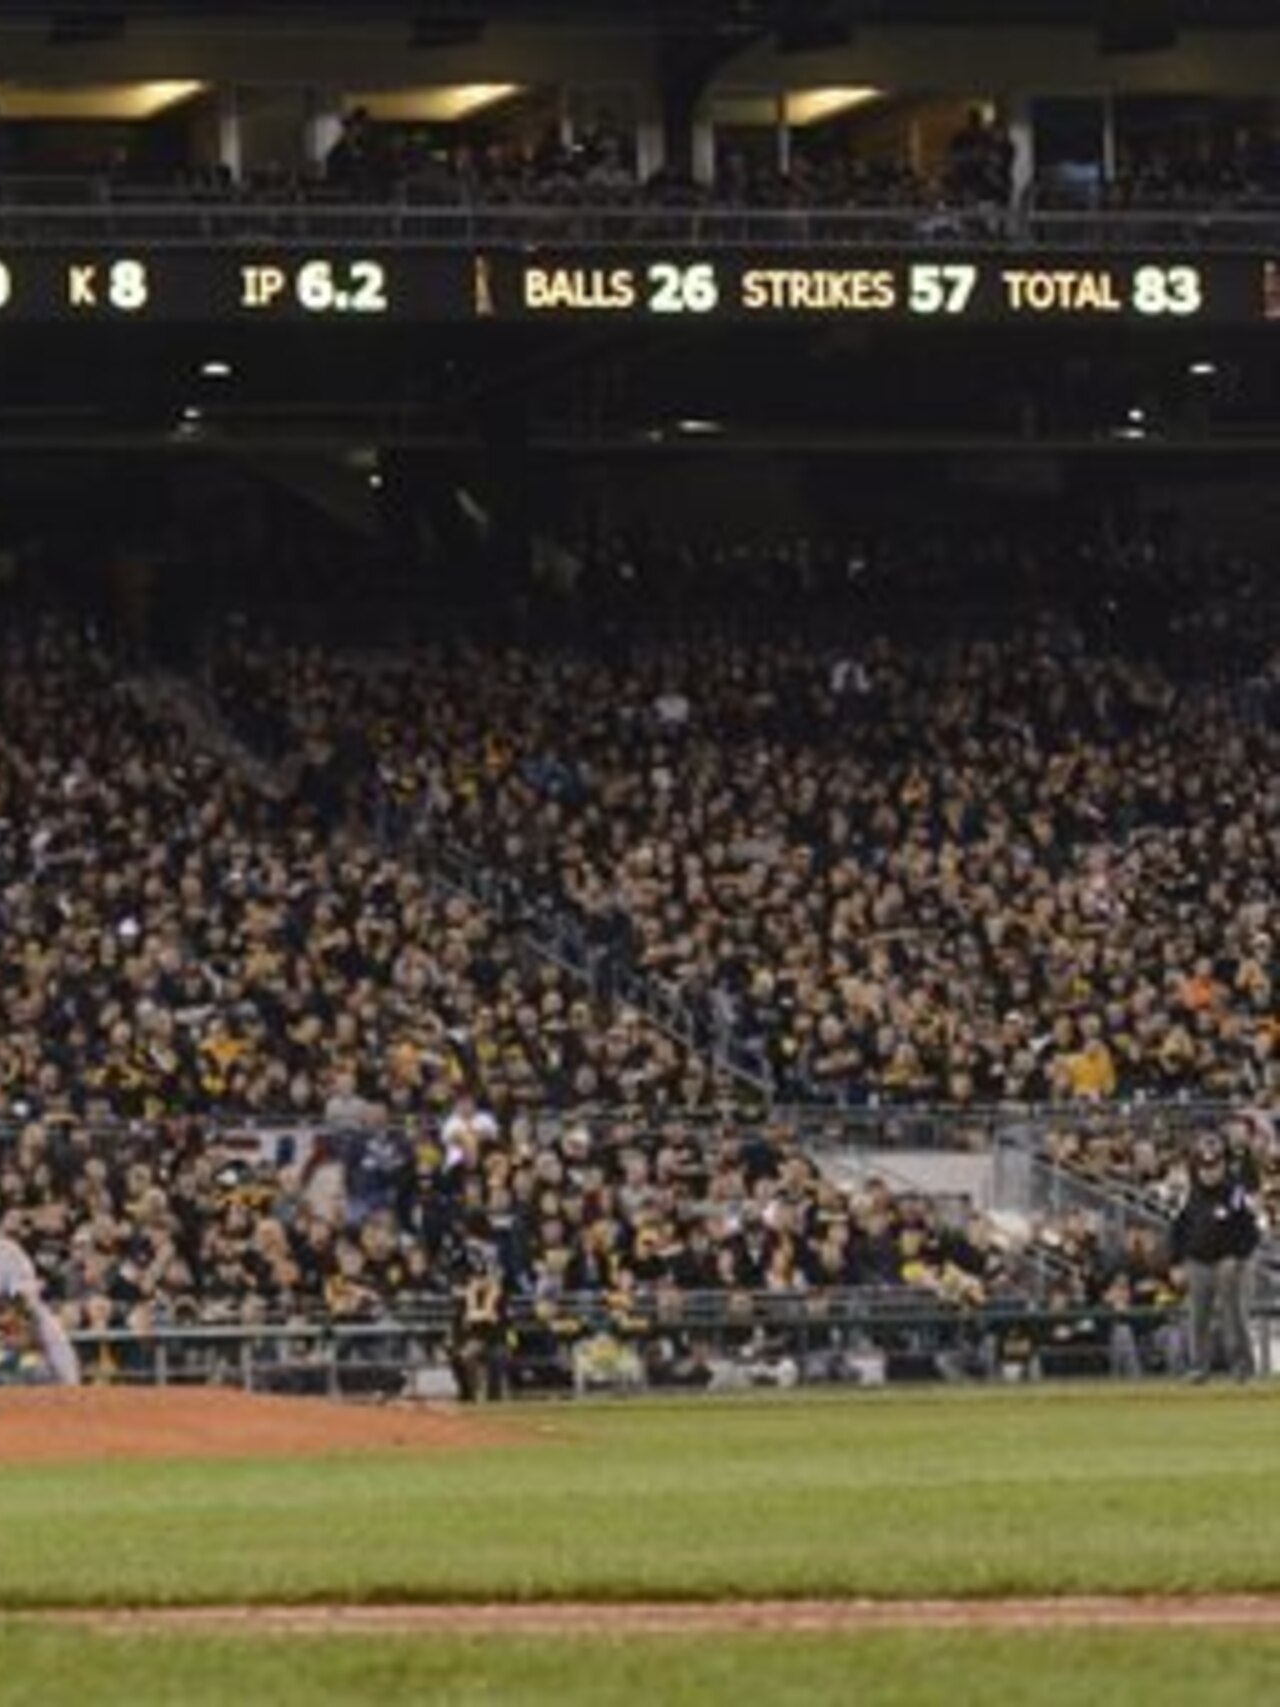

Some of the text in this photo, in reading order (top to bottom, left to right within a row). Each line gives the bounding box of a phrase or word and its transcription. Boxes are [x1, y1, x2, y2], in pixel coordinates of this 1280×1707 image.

[69, 266, 96, 304] K
[109, 260, 147, 308] 8
[242, 267, 285, 305] IP
[296, 261, 387, 310] 6.2
[524, 269, 635, 308] BALLS
[648, 263, 718, 311] 26
[741, 270, 896, 309] STRIKES
[909, 265, 977, 313] 57
[1002, 271, 1122, 310] TOTAL
[1132, 266, 1203, 314] 83
